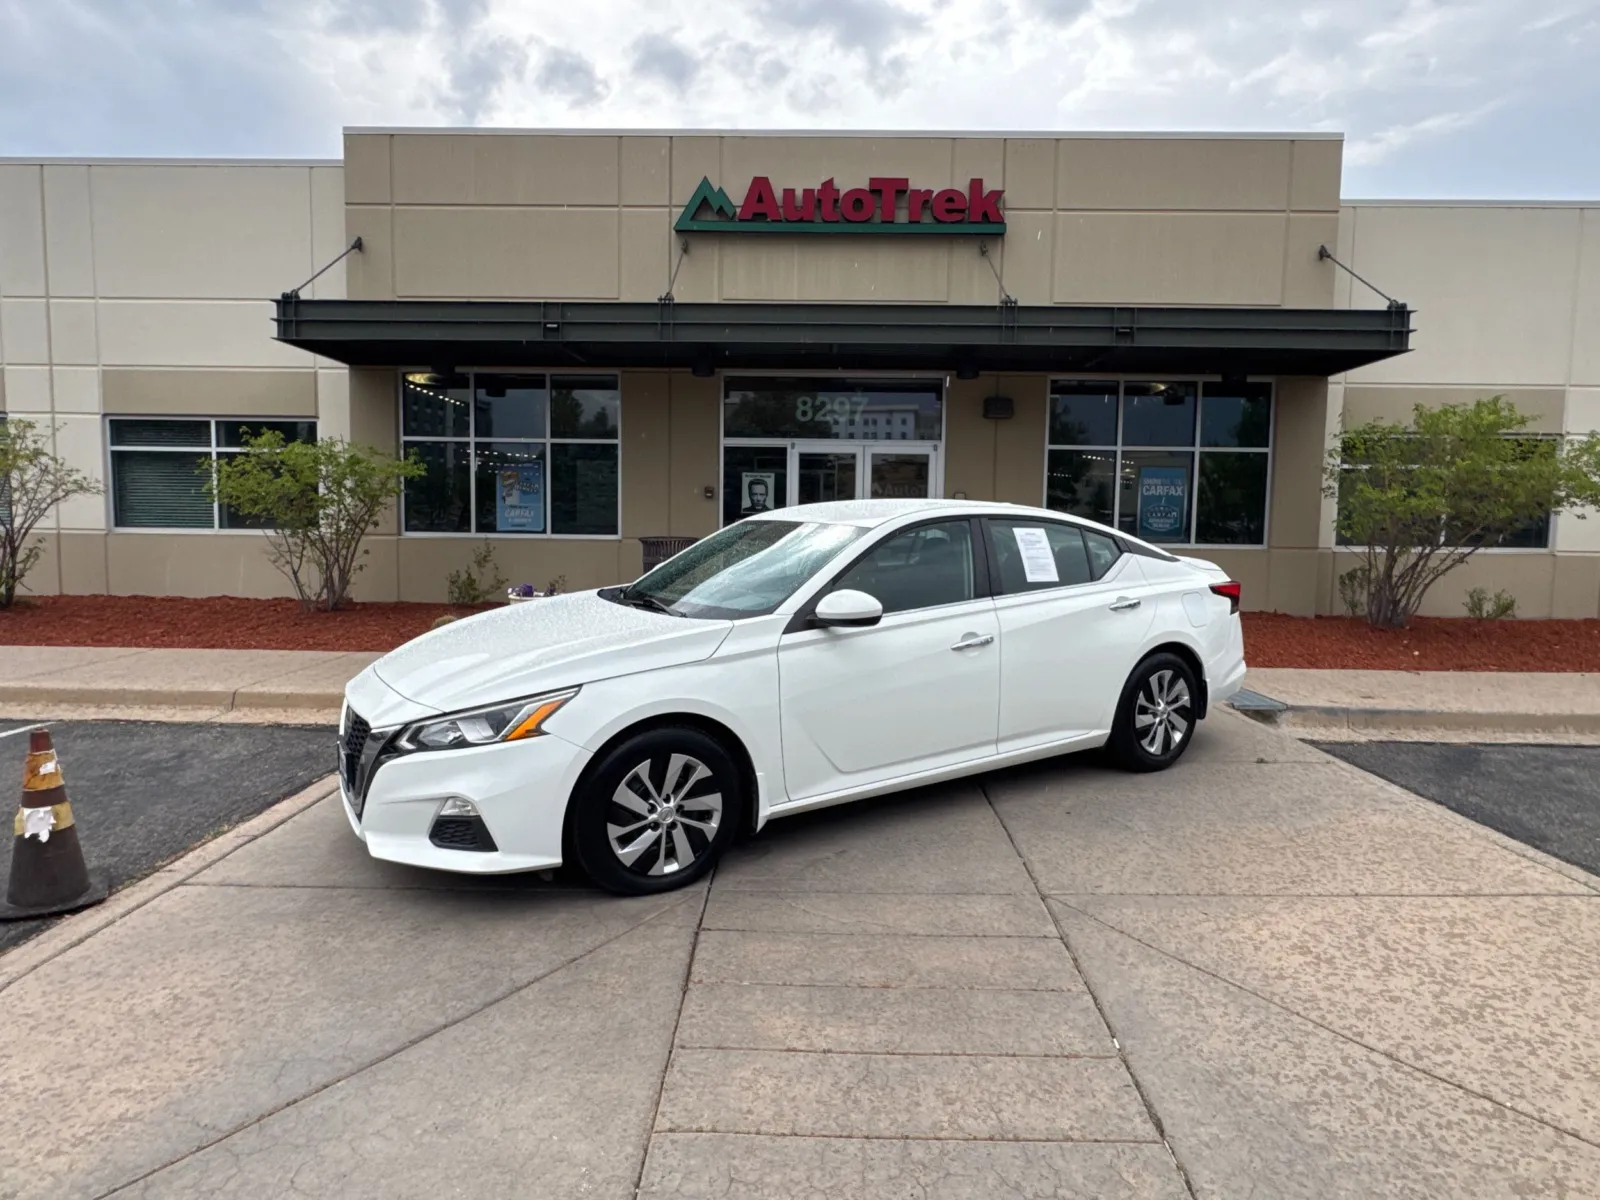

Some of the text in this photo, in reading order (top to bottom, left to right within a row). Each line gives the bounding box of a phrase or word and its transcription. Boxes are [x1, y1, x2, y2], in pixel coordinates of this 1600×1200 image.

[738, 176, 1005, 222] AutoTrek
[796, 396, 869, 421] 8297
[1143, 485, 1184, 496] CARFAX
